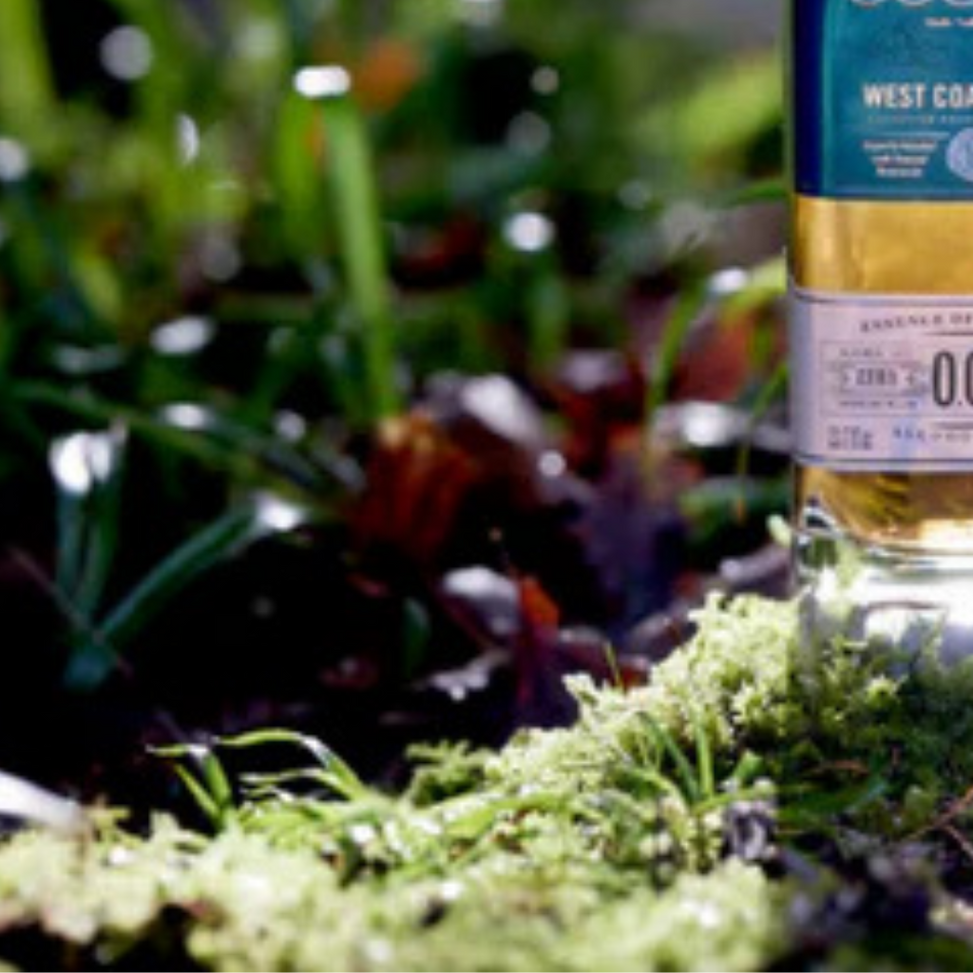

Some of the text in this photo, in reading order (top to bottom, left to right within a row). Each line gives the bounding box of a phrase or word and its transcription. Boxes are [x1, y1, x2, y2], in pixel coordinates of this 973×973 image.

[862, 82, 926, 110] WEST
[859, 314, 943, 333] ESSENCE
[949, 313, 973, 326] OF
